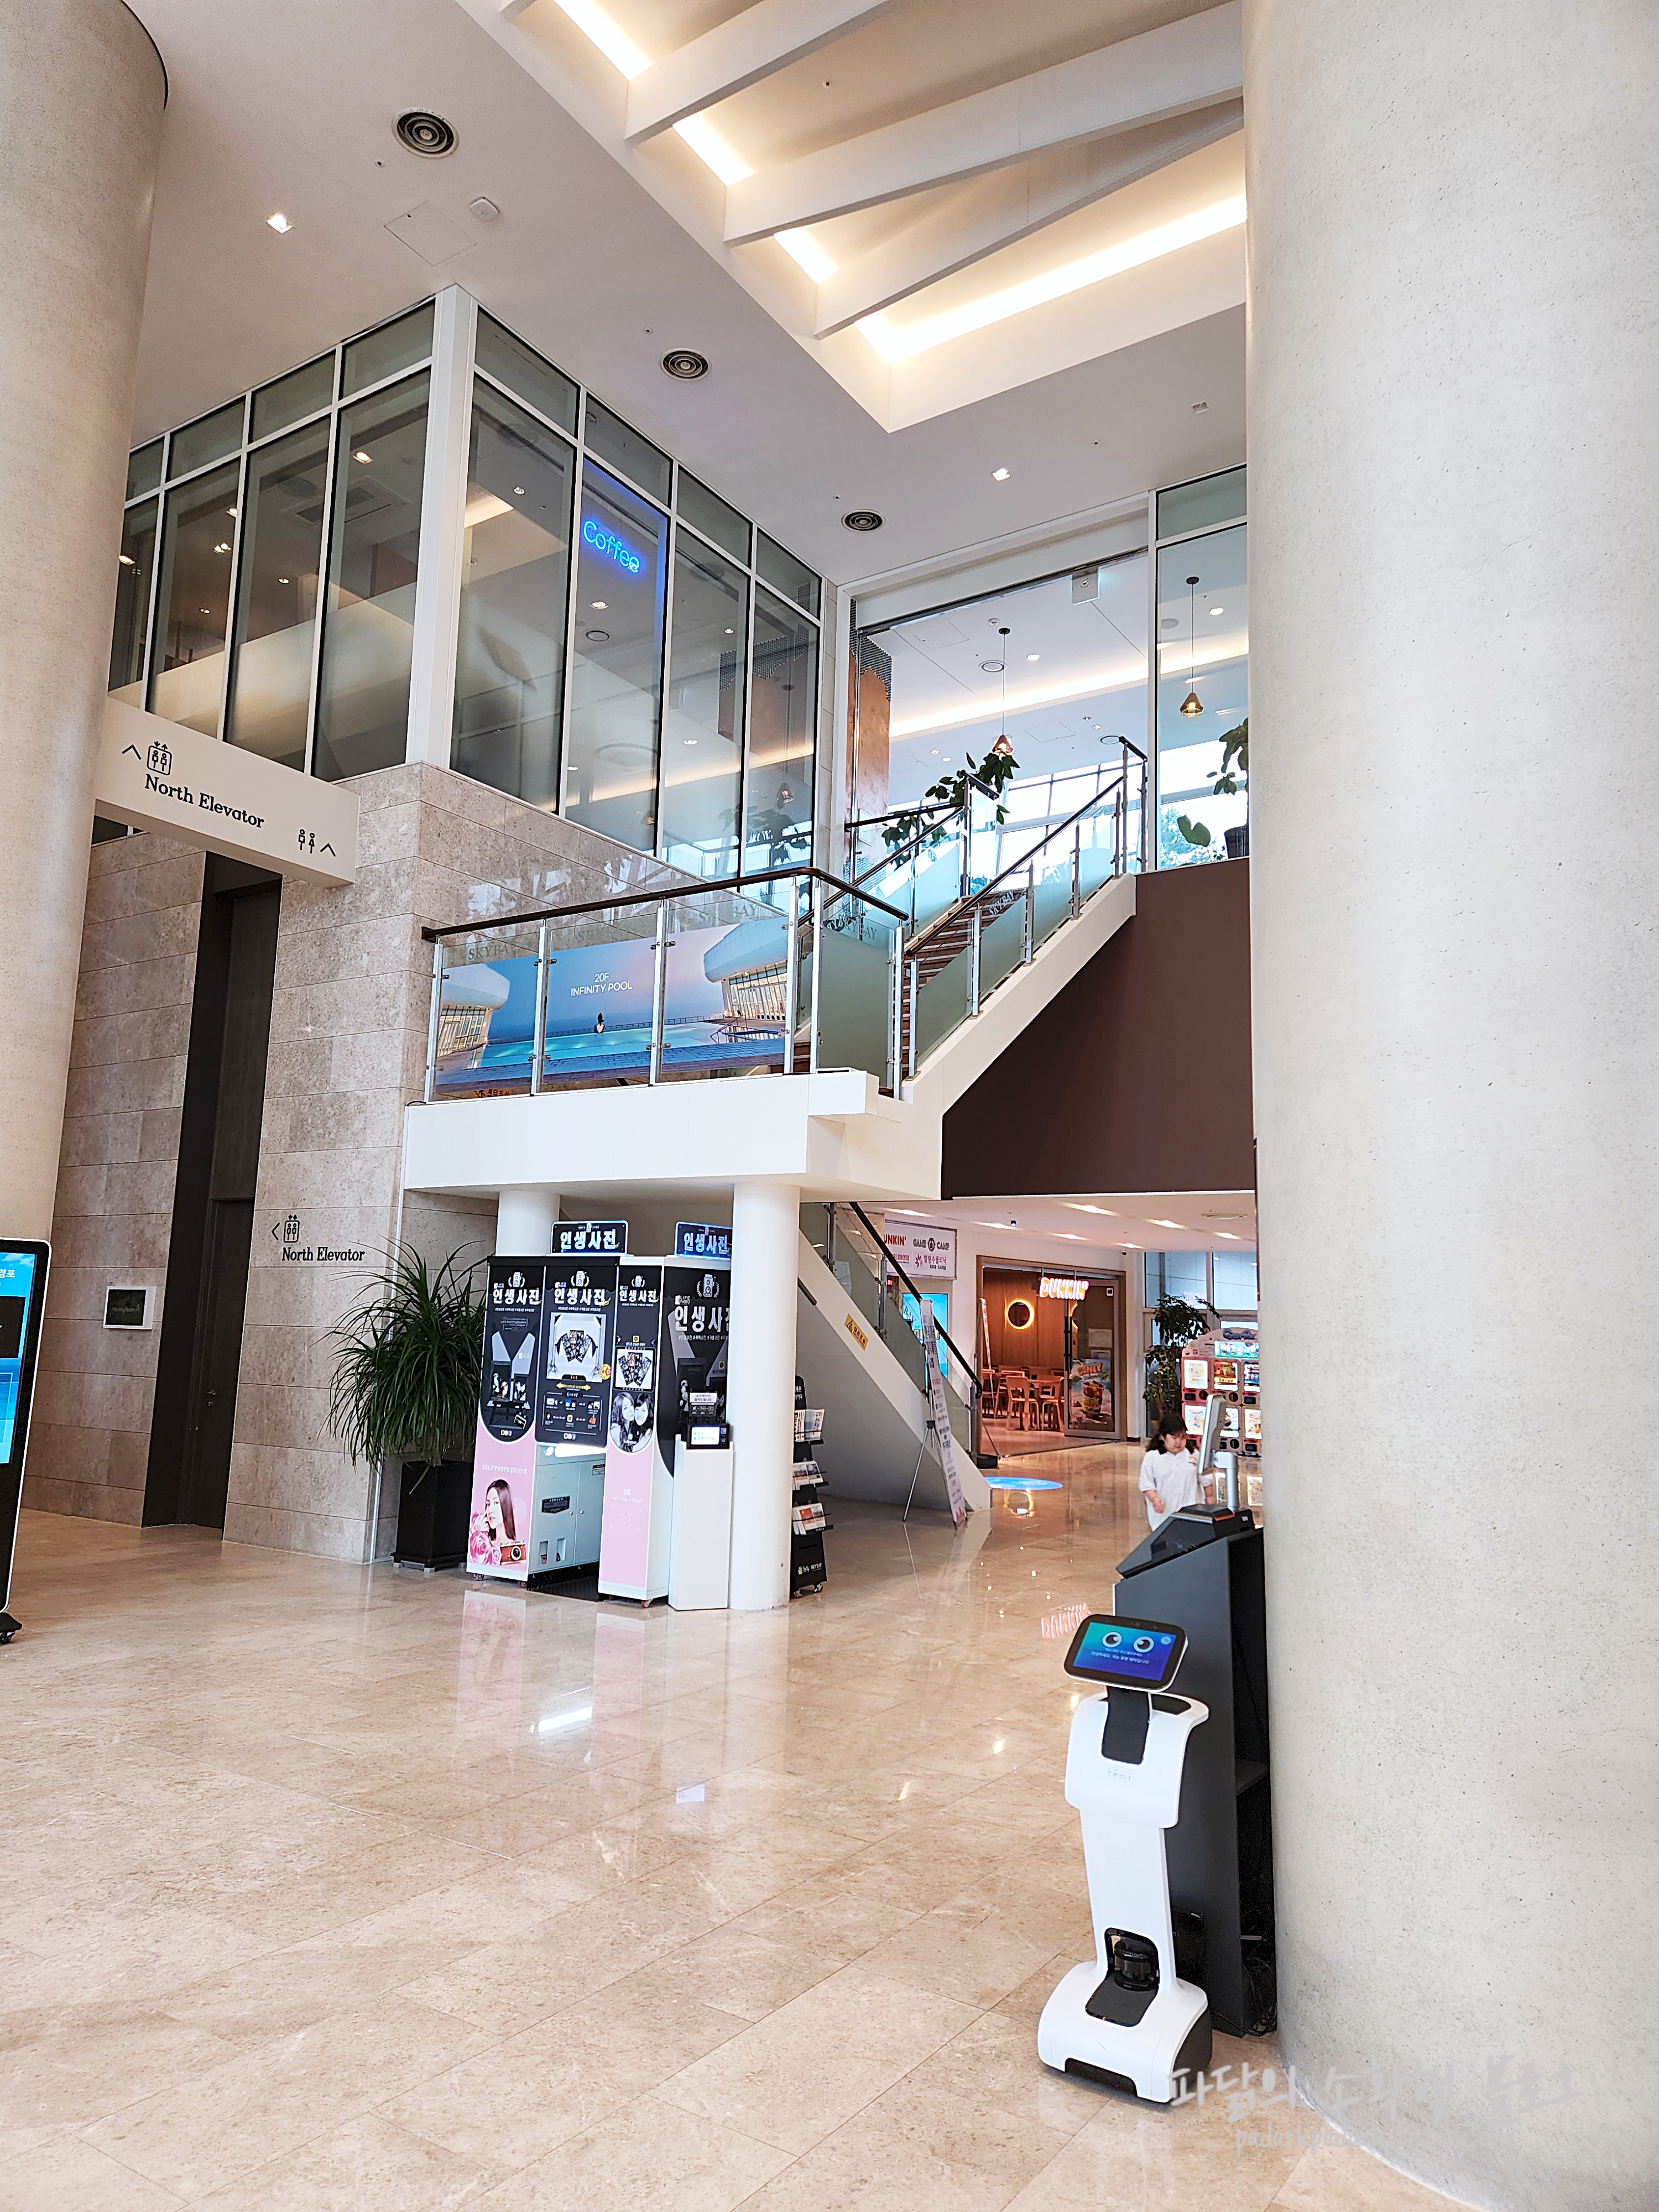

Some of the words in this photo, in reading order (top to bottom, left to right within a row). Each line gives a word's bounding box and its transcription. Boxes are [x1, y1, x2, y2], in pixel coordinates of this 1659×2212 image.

[583, 520, 640, 573] Coffee
[144, 774, 194, 804] North
[198, 791, 265, 828] Elevator
[594, 972, 610, 983] 20F
[571, 984, 607, 997] INFINITY
[608, 980, 633, 992] POOL
[560, 1229, 616, 1250] 인생사진
[684, 1232, 728, 1254] 인생사진
[884, 1234, 906, 1246] UNKIN'
[282, 1246, 314, 1261] North
[316, 1246, 365, 1261] Elevator
[493, 1287, 540, 1305] 인생사진
[554, 1288, 606, 1306] 인생사진
[619, 1289, 657, 1303] 인생사진
